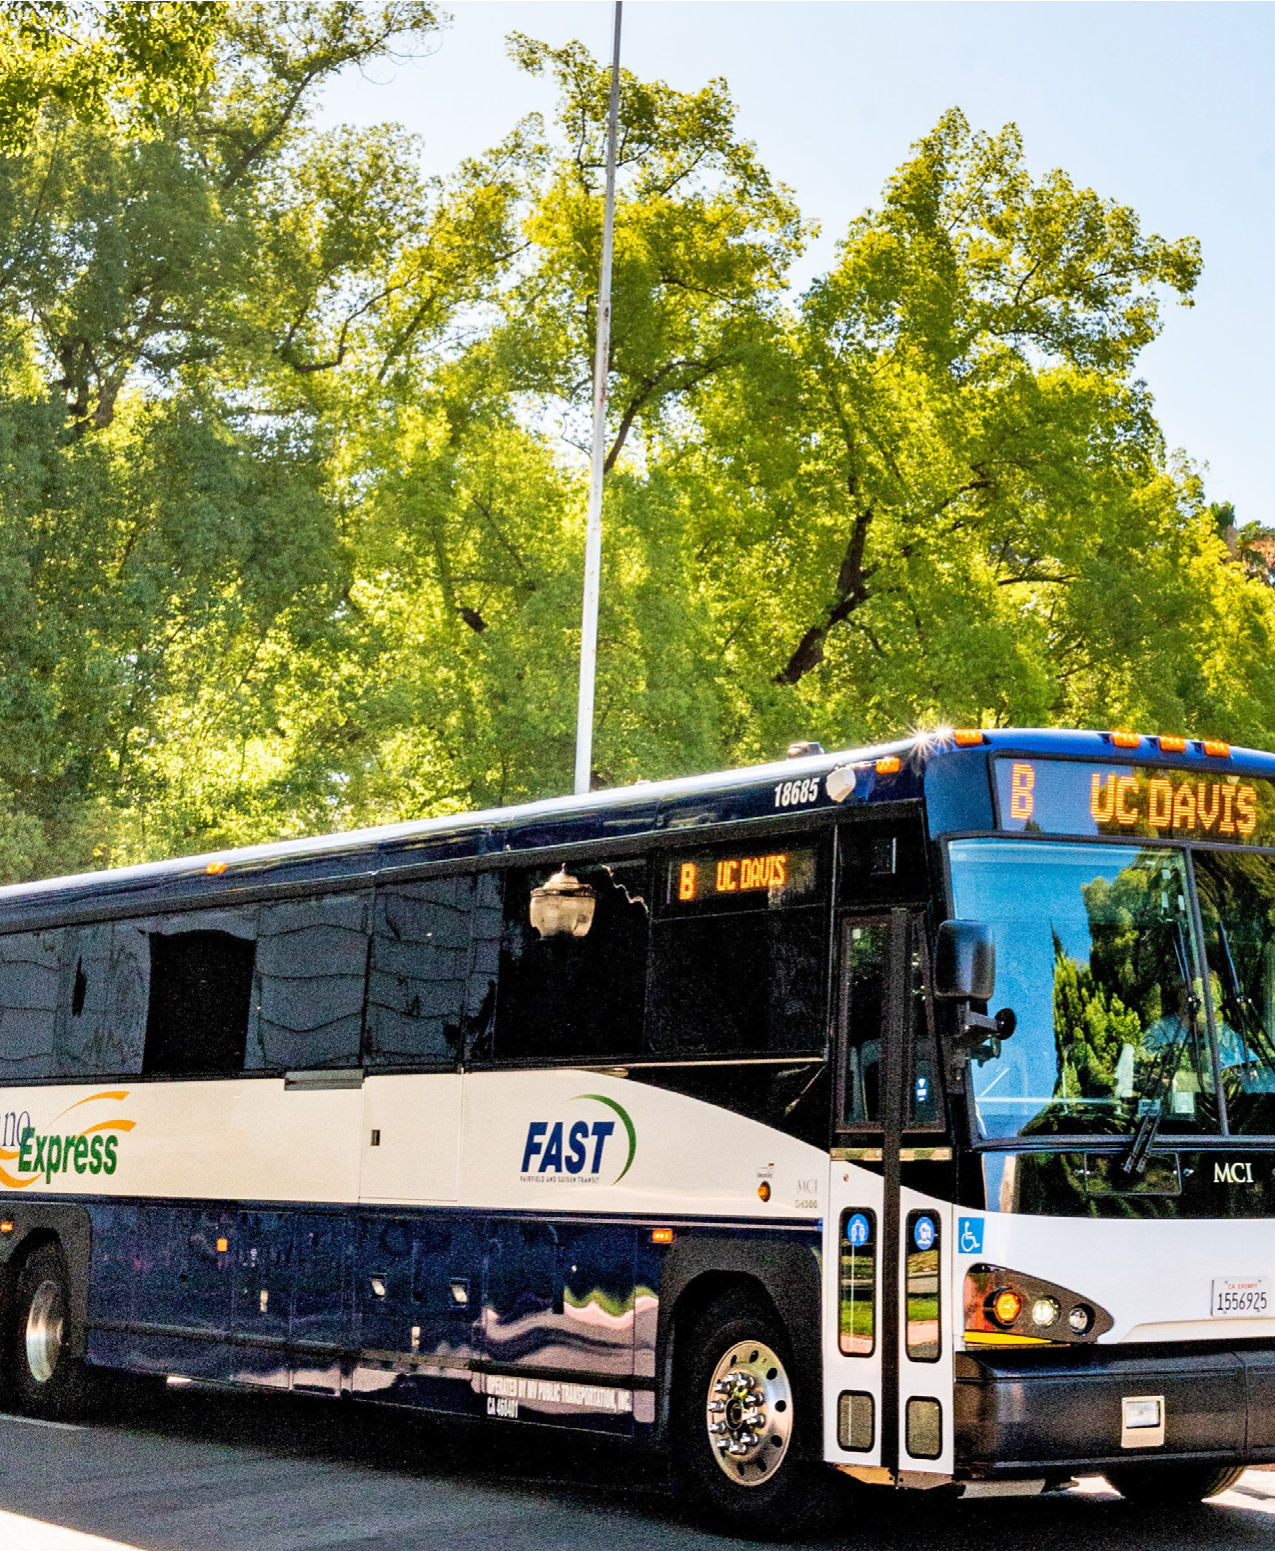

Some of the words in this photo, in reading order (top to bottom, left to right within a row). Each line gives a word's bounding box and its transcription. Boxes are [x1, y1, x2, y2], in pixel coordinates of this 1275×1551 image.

[774, 777, 821, 807] 18685
[1010, 762, 1035, 820] B
[1090, 773, 1140, 824] UC
[1149, 778, 1258, 834] DAVIS
[679, 862, 697, 901] B
[716, 860, 739, 892] UC
[740, 854, 787, 889] DAVIS
[0, 1110, 30, 1147] no
[18, 1126, 119, 1185] Express
[521, 1120, 616, 1175] FAST
[520, 1175, 545, 1183] FAIRFIELD
[546, 1175, 556, 1183] AND
[577, 1176, 600, 1184] TRANSIT
[796, 1179, 818, 1194] MCI
[1213, 1162, 1254, 1183] MCI
[1217, 1291, 1267, 1310] 1556925
[487, 1374, 518, 1397] OPERATED
[518, 1379, 527, 1399] BY
[538, 1381, 561, 1403] PUBLIC
[487, 1396, 496, 1415] CA
